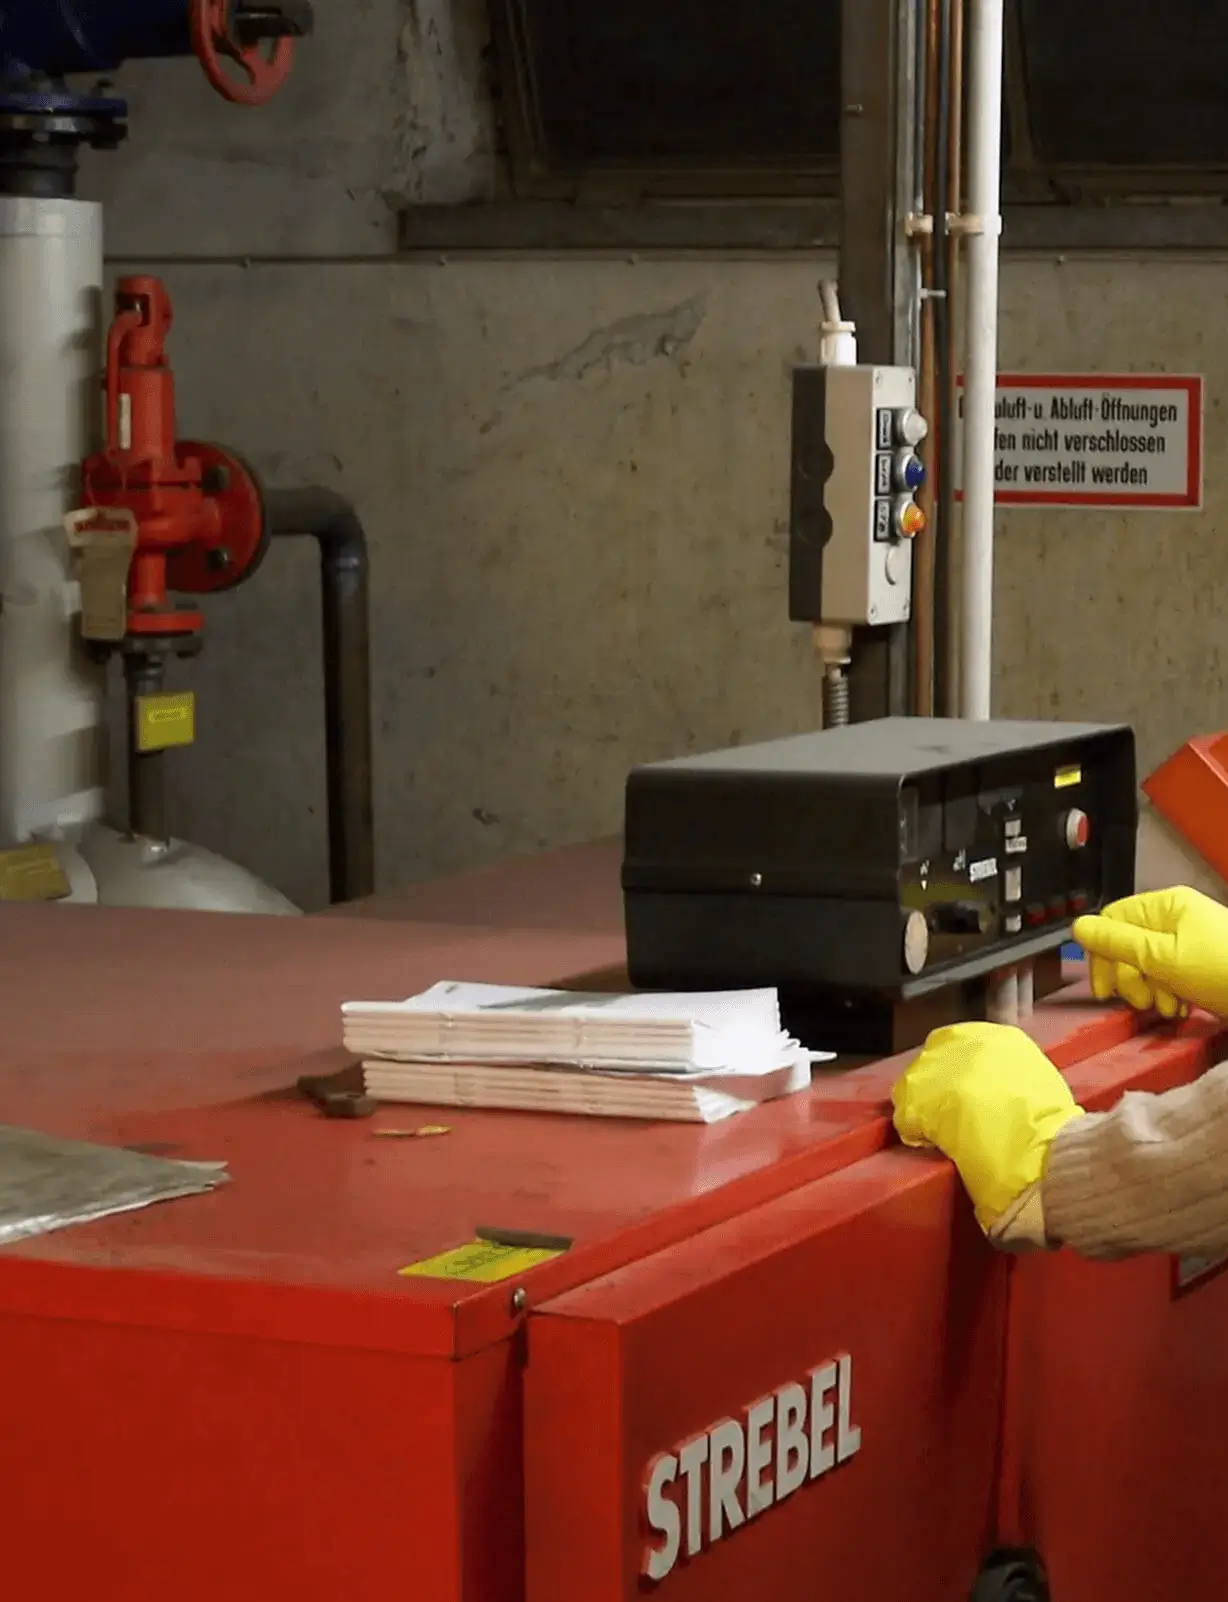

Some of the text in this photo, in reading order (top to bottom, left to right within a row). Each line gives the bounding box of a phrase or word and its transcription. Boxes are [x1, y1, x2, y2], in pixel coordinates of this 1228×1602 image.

[1022, 428, 1058, 452] nicht
[1064, 428, 1166, 453] verschlossen
[995, 459, 1148, 485] der verstellt werden
[643, 1352, 861, 1581] STREBEL
